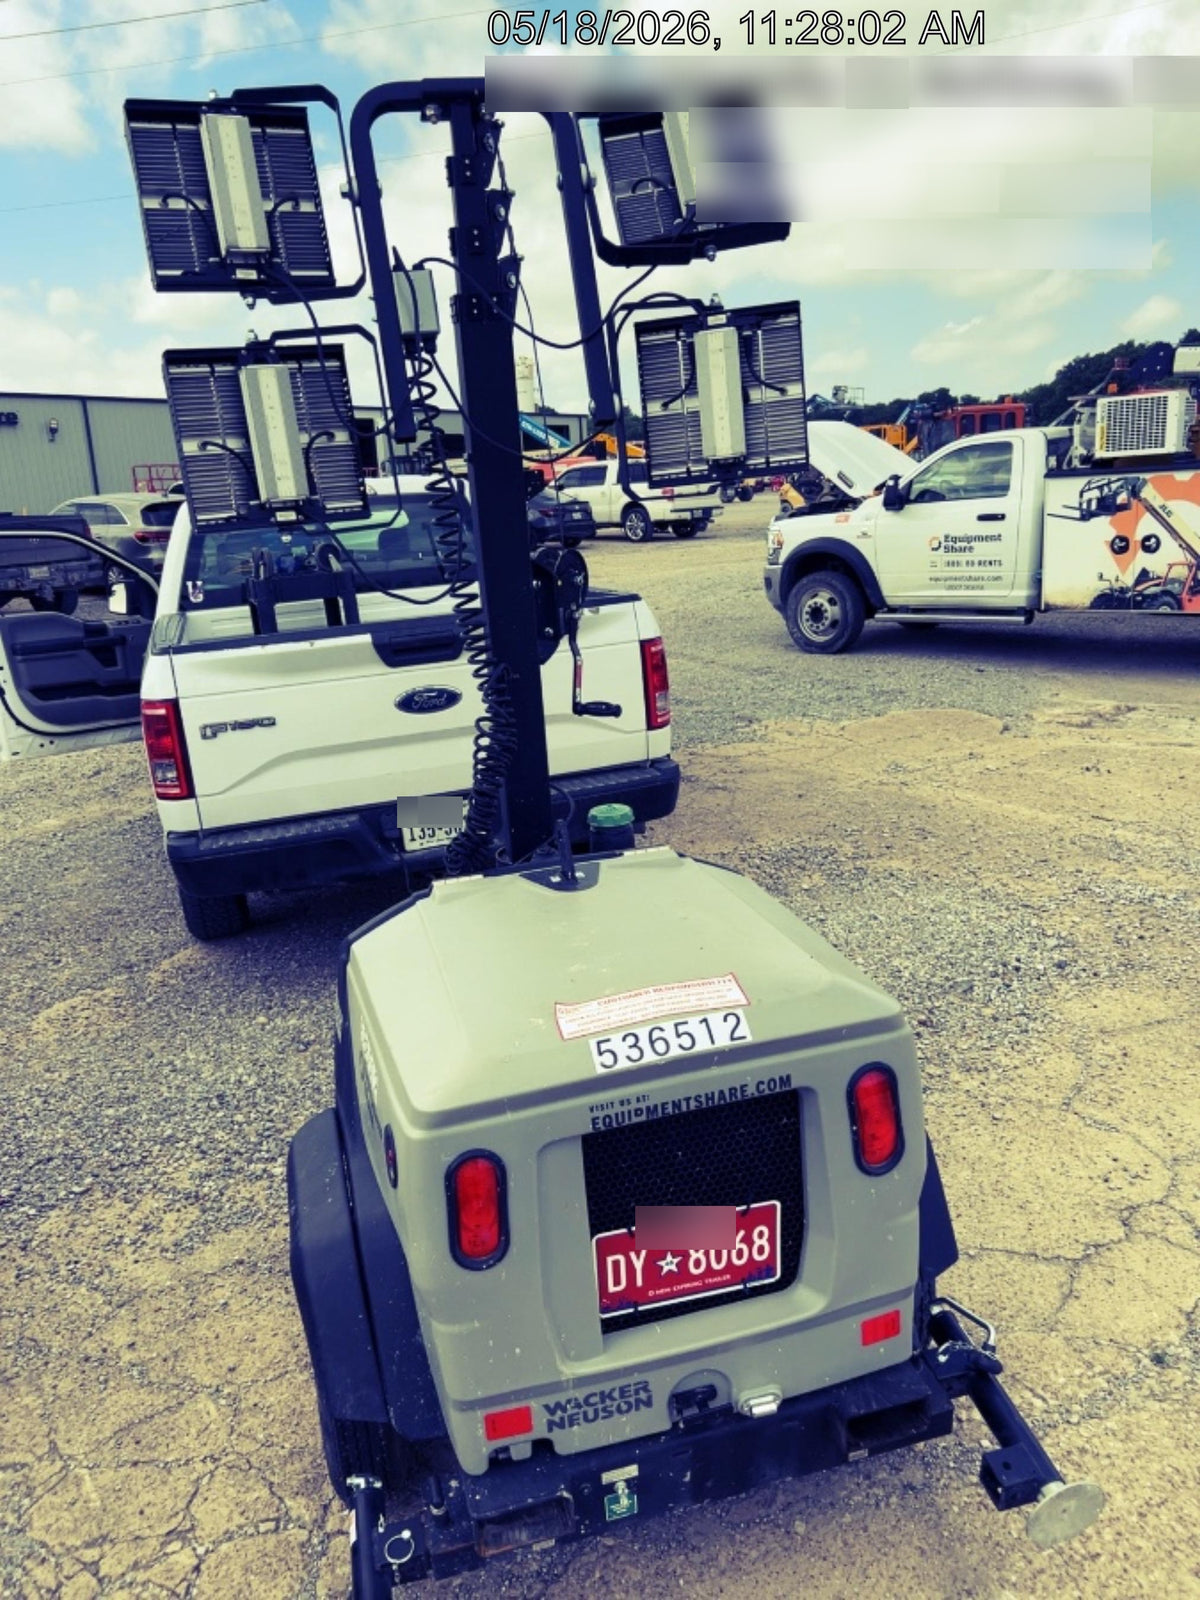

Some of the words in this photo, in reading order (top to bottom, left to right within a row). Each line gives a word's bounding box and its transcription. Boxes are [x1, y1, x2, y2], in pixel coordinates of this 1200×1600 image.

[943, 533, 1003, 545] Equipment
[943, 544, 975, 553] Share
[929, 575, 1003, 583] equipmentshare.com
[595, 1012, 747, 1069] 536512
[589, 1101, 615, 1113] VISIT
[619, 1098, 632, 1107] US
[591, 1073, 792, 1132] EQUIPMENTSHARE.COM
[542, 1380, 653, 1417] WACKER
[546, 1394, 653, 1433] NEUSON
